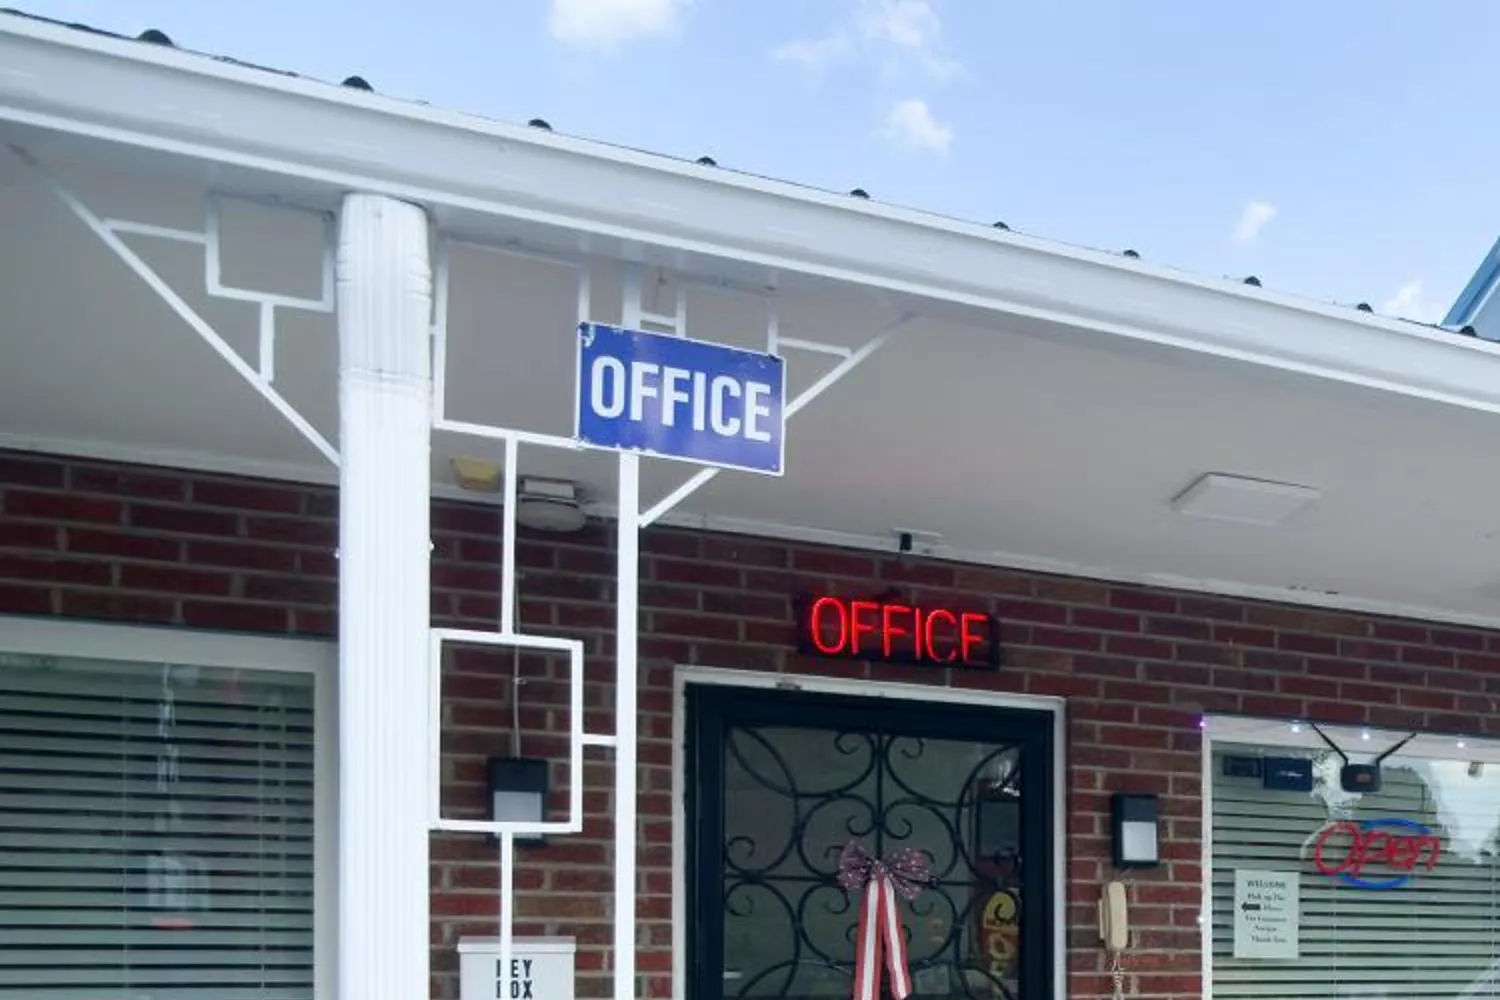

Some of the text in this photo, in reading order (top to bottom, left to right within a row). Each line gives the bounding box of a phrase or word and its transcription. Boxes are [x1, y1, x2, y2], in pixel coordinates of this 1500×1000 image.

[589, 355, 772, 444] OFFICE
[809, 595, 990, 664] OFFICE
[1313, 821, 1442, 877] Open
